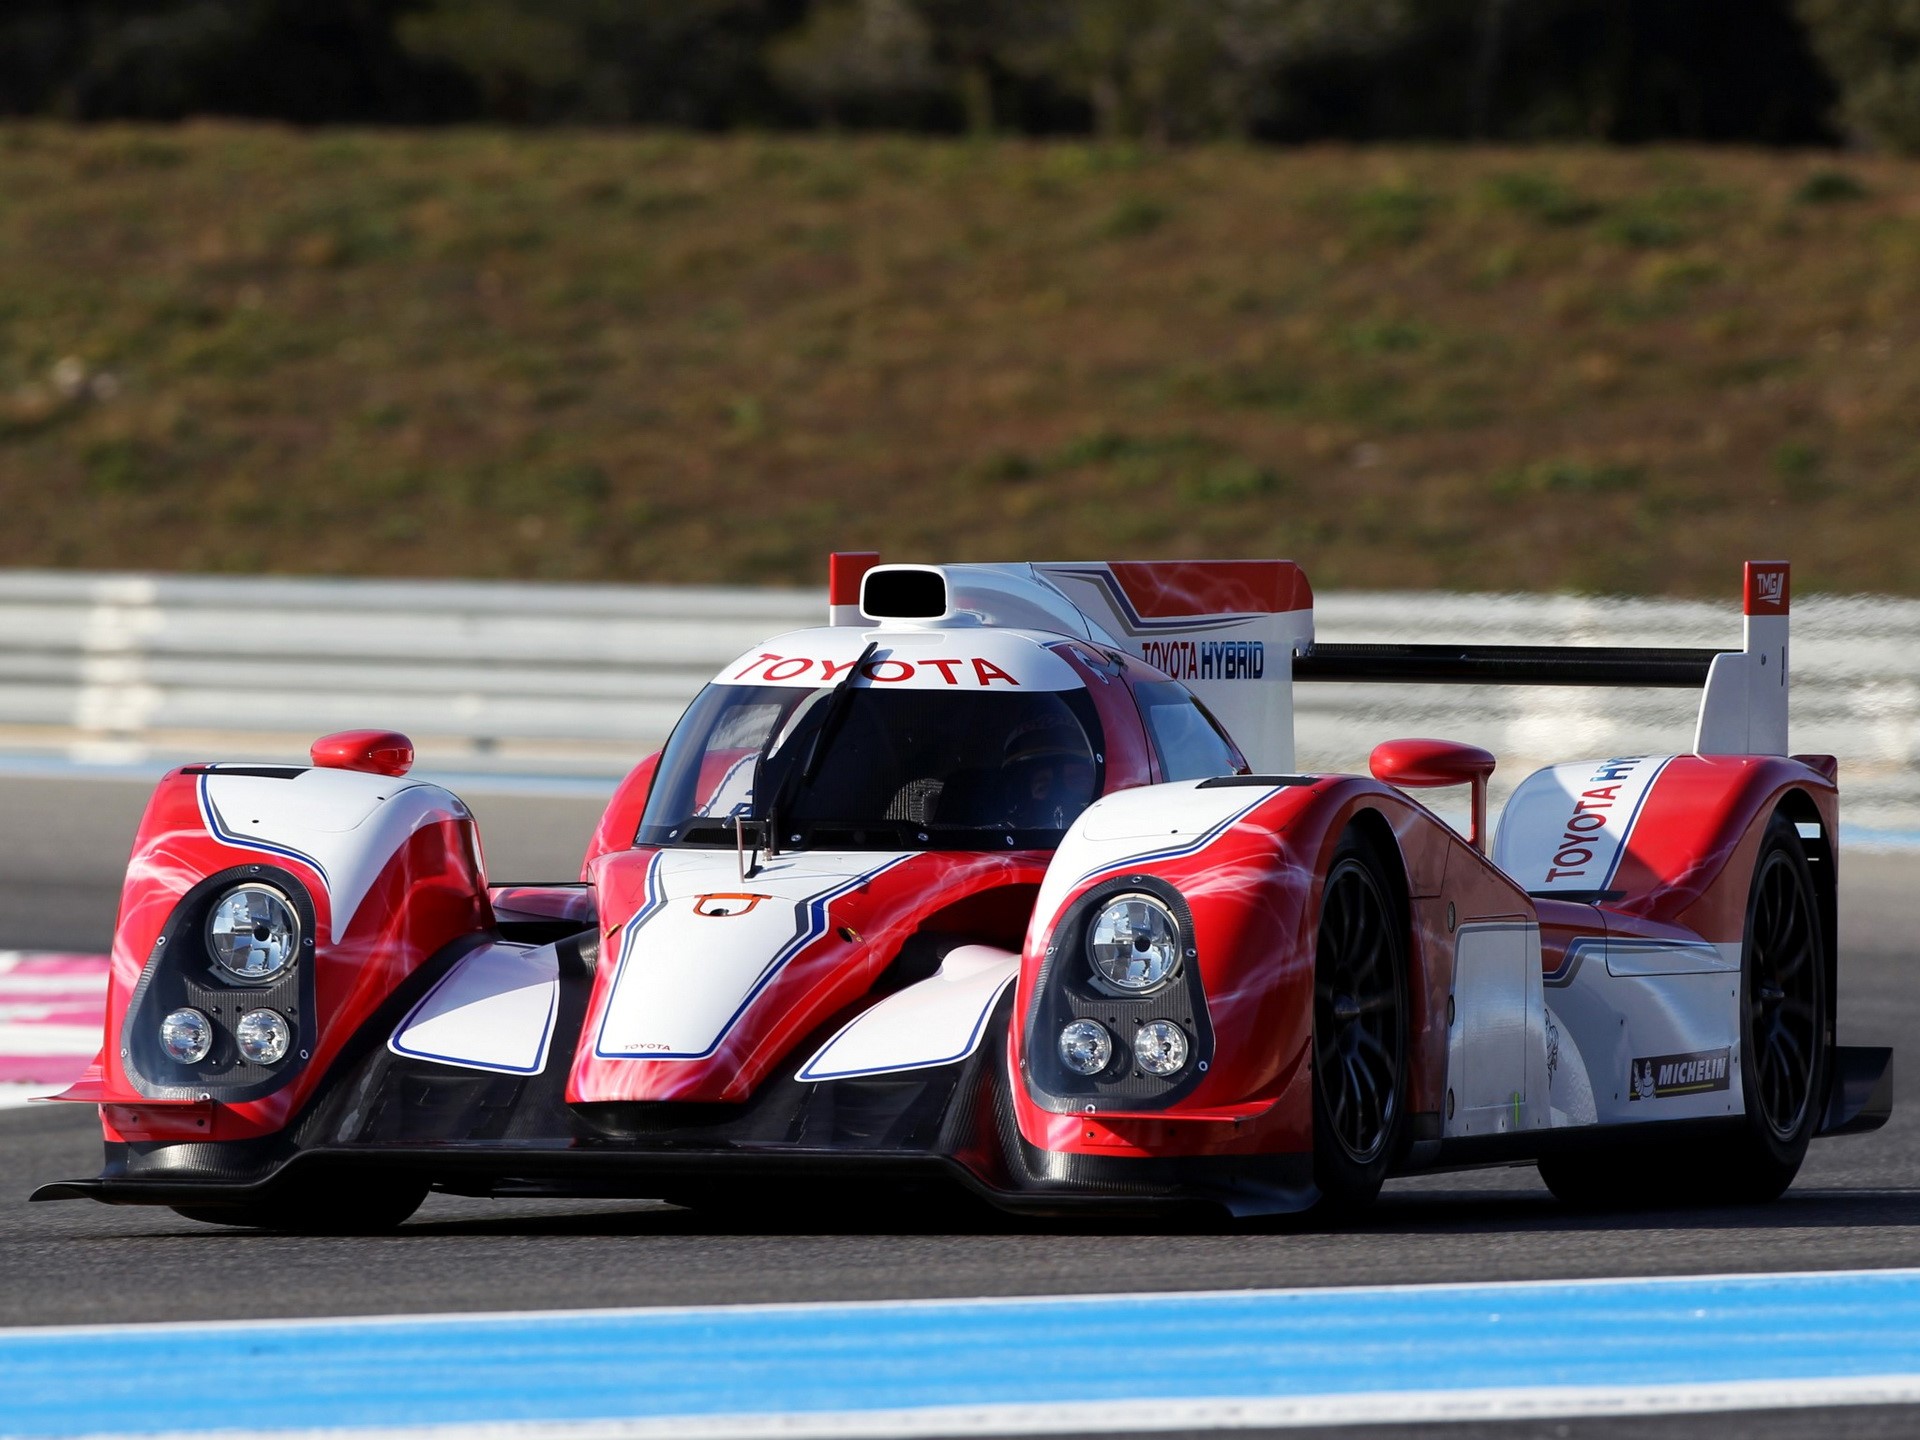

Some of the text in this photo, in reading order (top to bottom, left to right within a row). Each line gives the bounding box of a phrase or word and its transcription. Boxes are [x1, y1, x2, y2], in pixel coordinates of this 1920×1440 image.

[734, 653, 1020, 686] TOYOTA
[1142, 641, 1264, 680] TOYOTA HYBRID
[1544, 755, 1648, 883] TOYOTA HY
[624, 1043, 671, 1051] TOYOTA
[1658, 1058, 1727, 1086] MICHELIN
